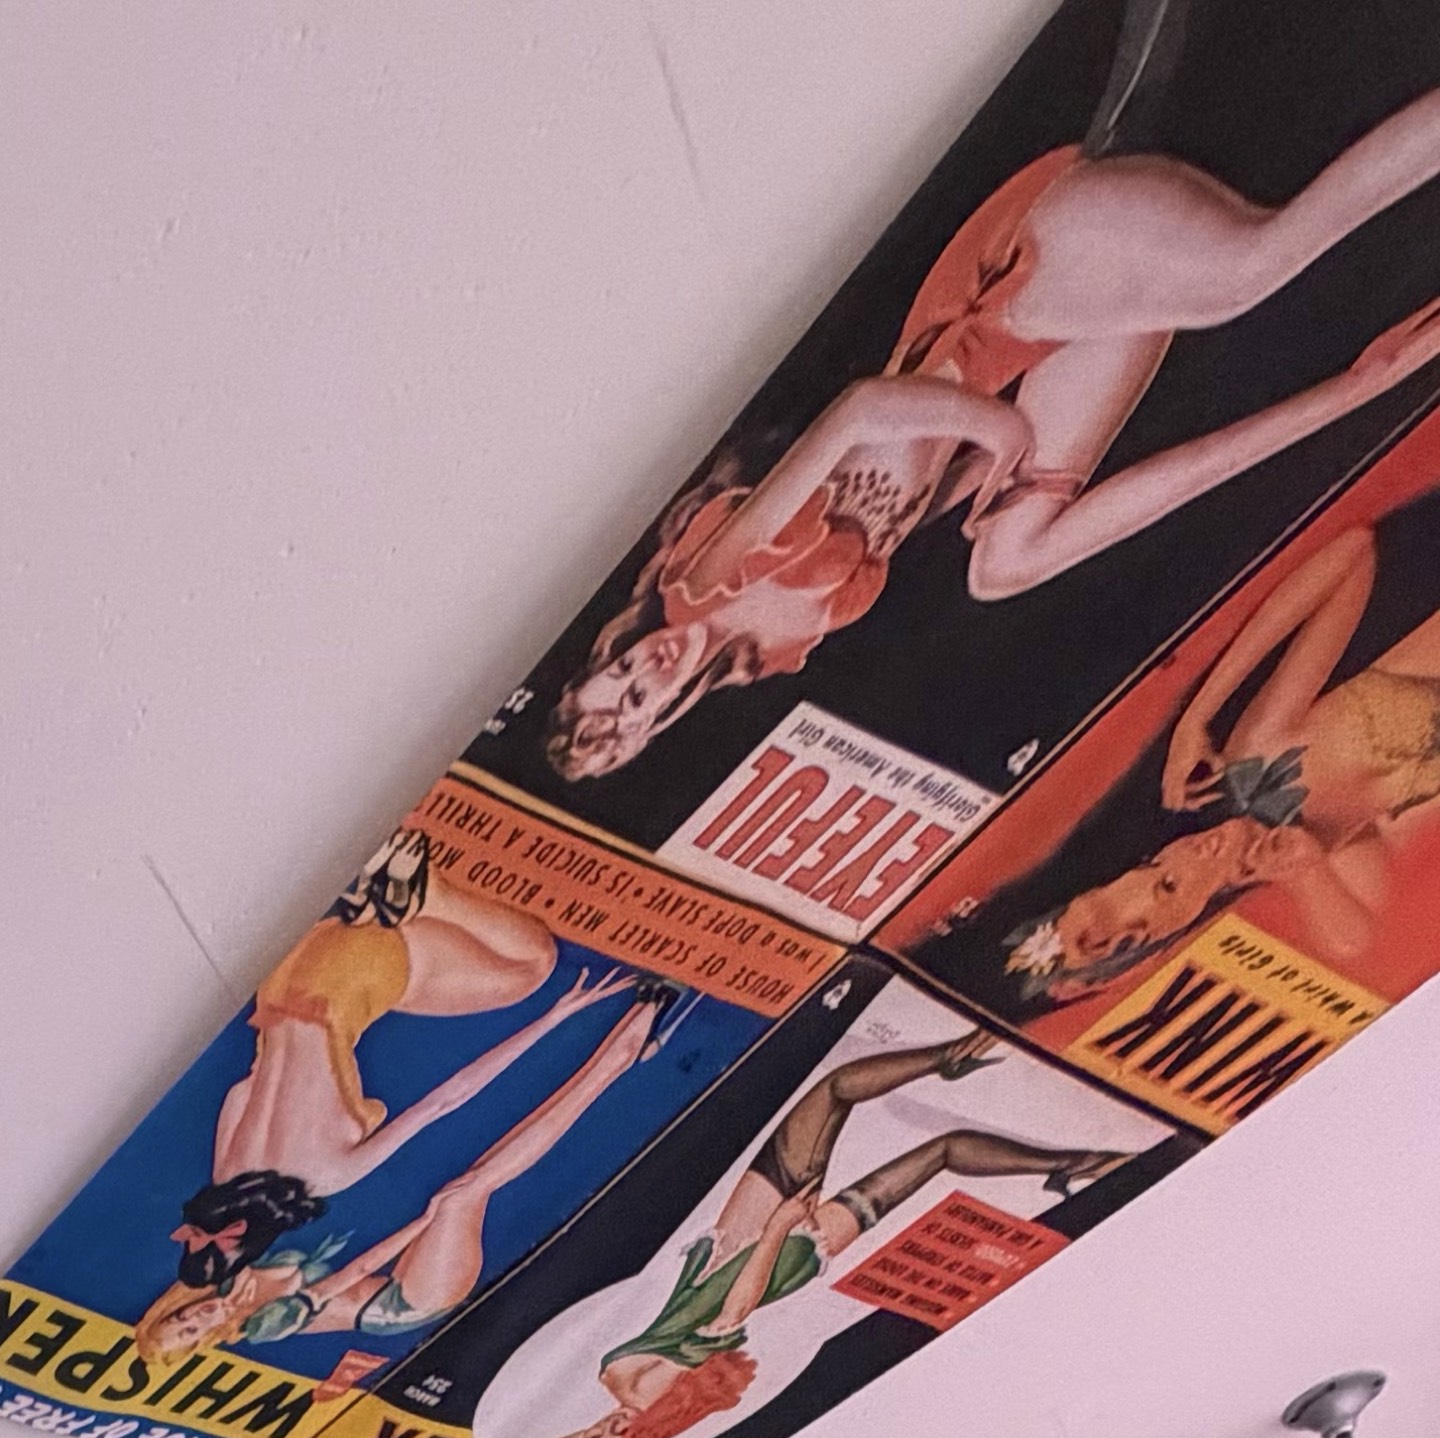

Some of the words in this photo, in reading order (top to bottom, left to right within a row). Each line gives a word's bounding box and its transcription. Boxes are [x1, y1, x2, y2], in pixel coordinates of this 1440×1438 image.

[787, 717, 825, 748] Girl
[821, 733, 893, 780] American
[886, 765, 917, 789] the
[912, 771, 982, 823] Glorifying
[505, 830, 524, 852] A
[691, 744, 961, 923] EYEFUL
[521, 835, 606, 883] SUICIDE
[465, 858, 544, 907] BLOOD
[557, 899, 611, 935] MEN
[646, 885, 709, 928] SLAVE
[701, 903, 760, 946] DOPE
[606, 921, 699, 967] SCARLET
[698, 950, 728, 978] OF
[775, 938, 813, 965] was
[1217, 933, 1276, 973] Girls
[737, 969, 798, 1003] HOUSE
[1092, 961, 1332, 1122] WINK
